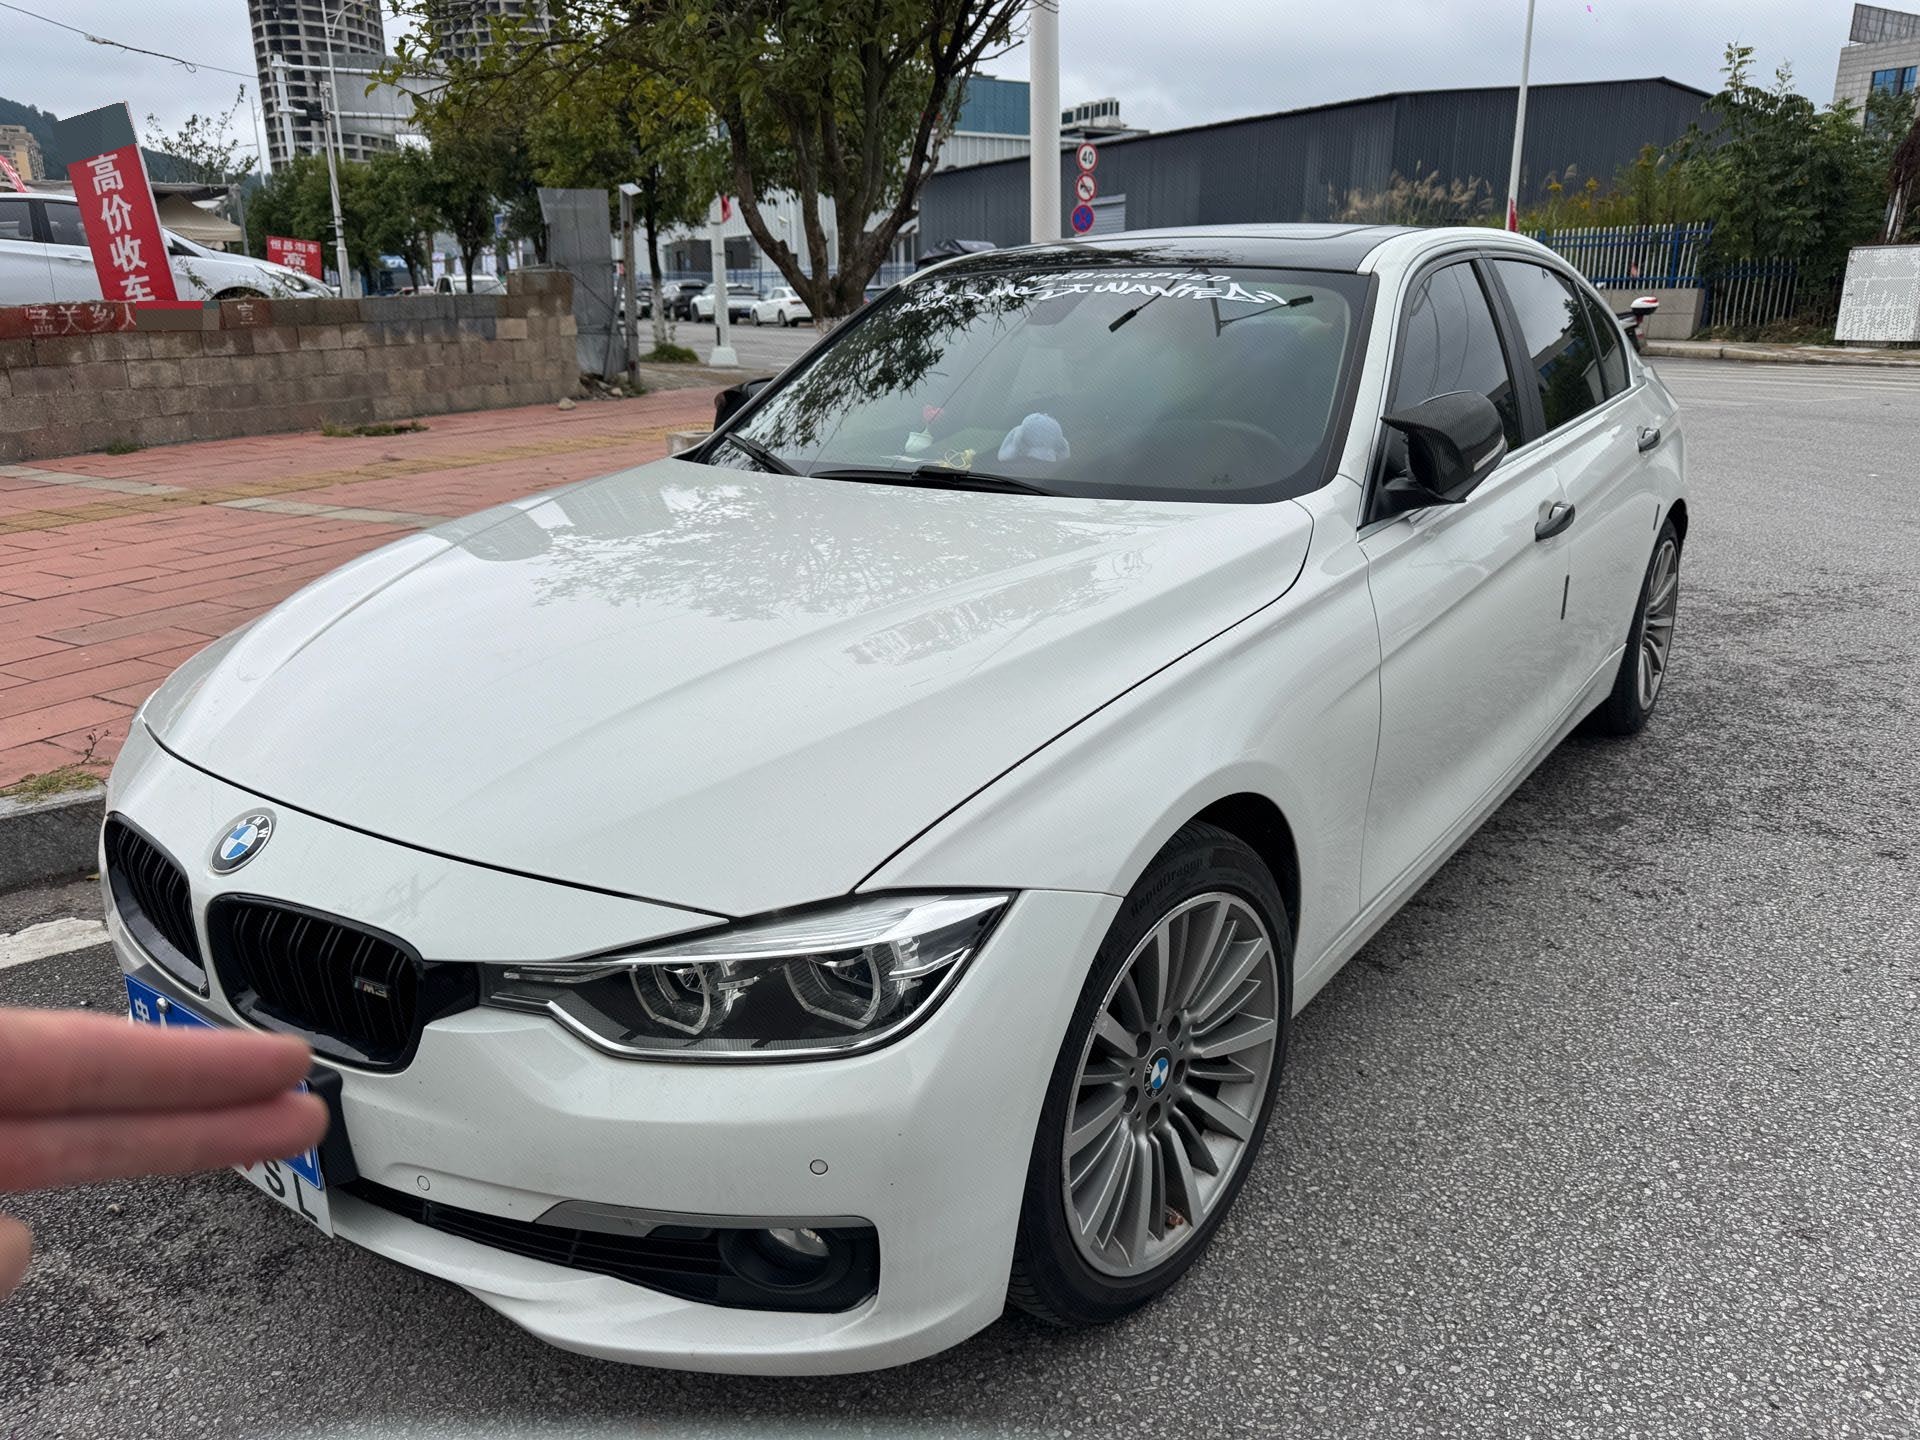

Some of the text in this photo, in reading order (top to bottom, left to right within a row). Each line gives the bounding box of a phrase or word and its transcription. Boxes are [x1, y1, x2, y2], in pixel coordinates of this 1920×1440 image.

[1082, 151, 1093, 165] 40
[86, 153, 156, 301] 高价收车
[1023, 272, 1094, 283] NEED
[1131, 271, 1232, 282] SPEED
